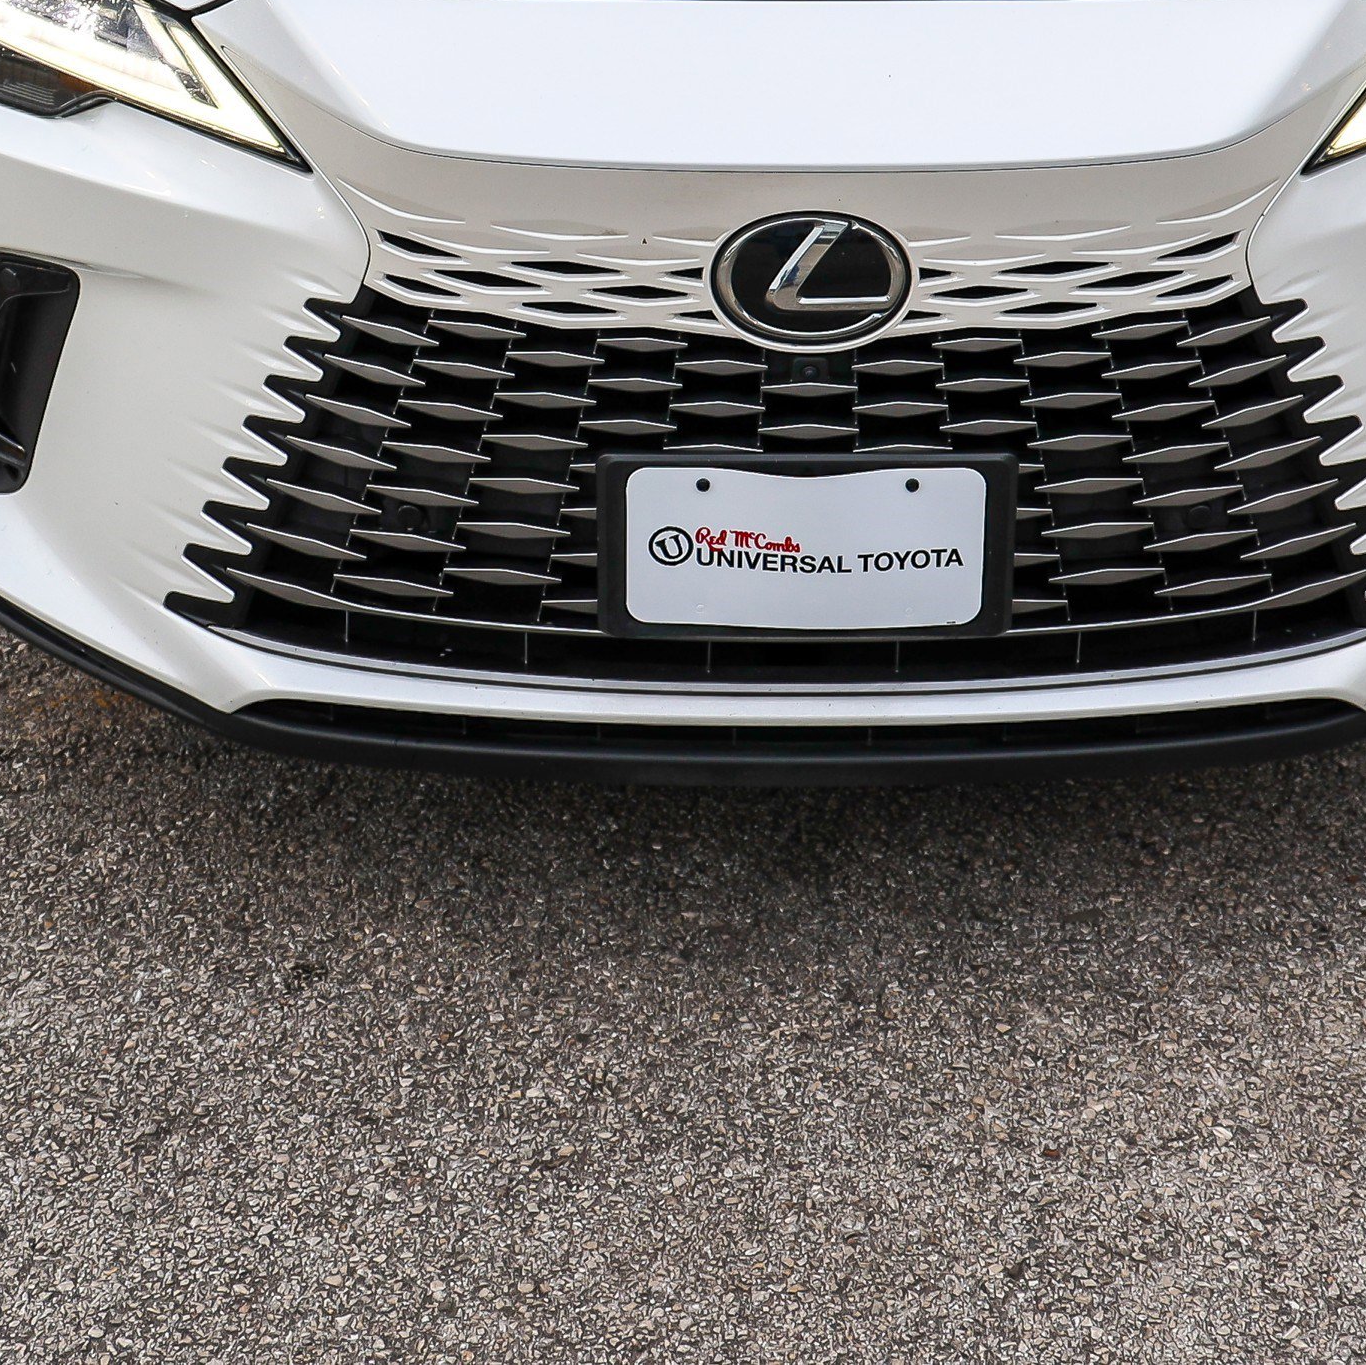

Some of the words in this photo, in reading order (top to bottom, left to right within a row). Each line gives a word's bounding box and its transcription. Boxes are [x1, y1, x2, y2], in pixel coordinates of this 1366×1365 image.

[695, 527, 727, 552] Red
[730, 530, 801, 553] McCombs
[696, 548, 852, 574] UNIVERSAL
[857, 548, 964, 573] TOYOTA
